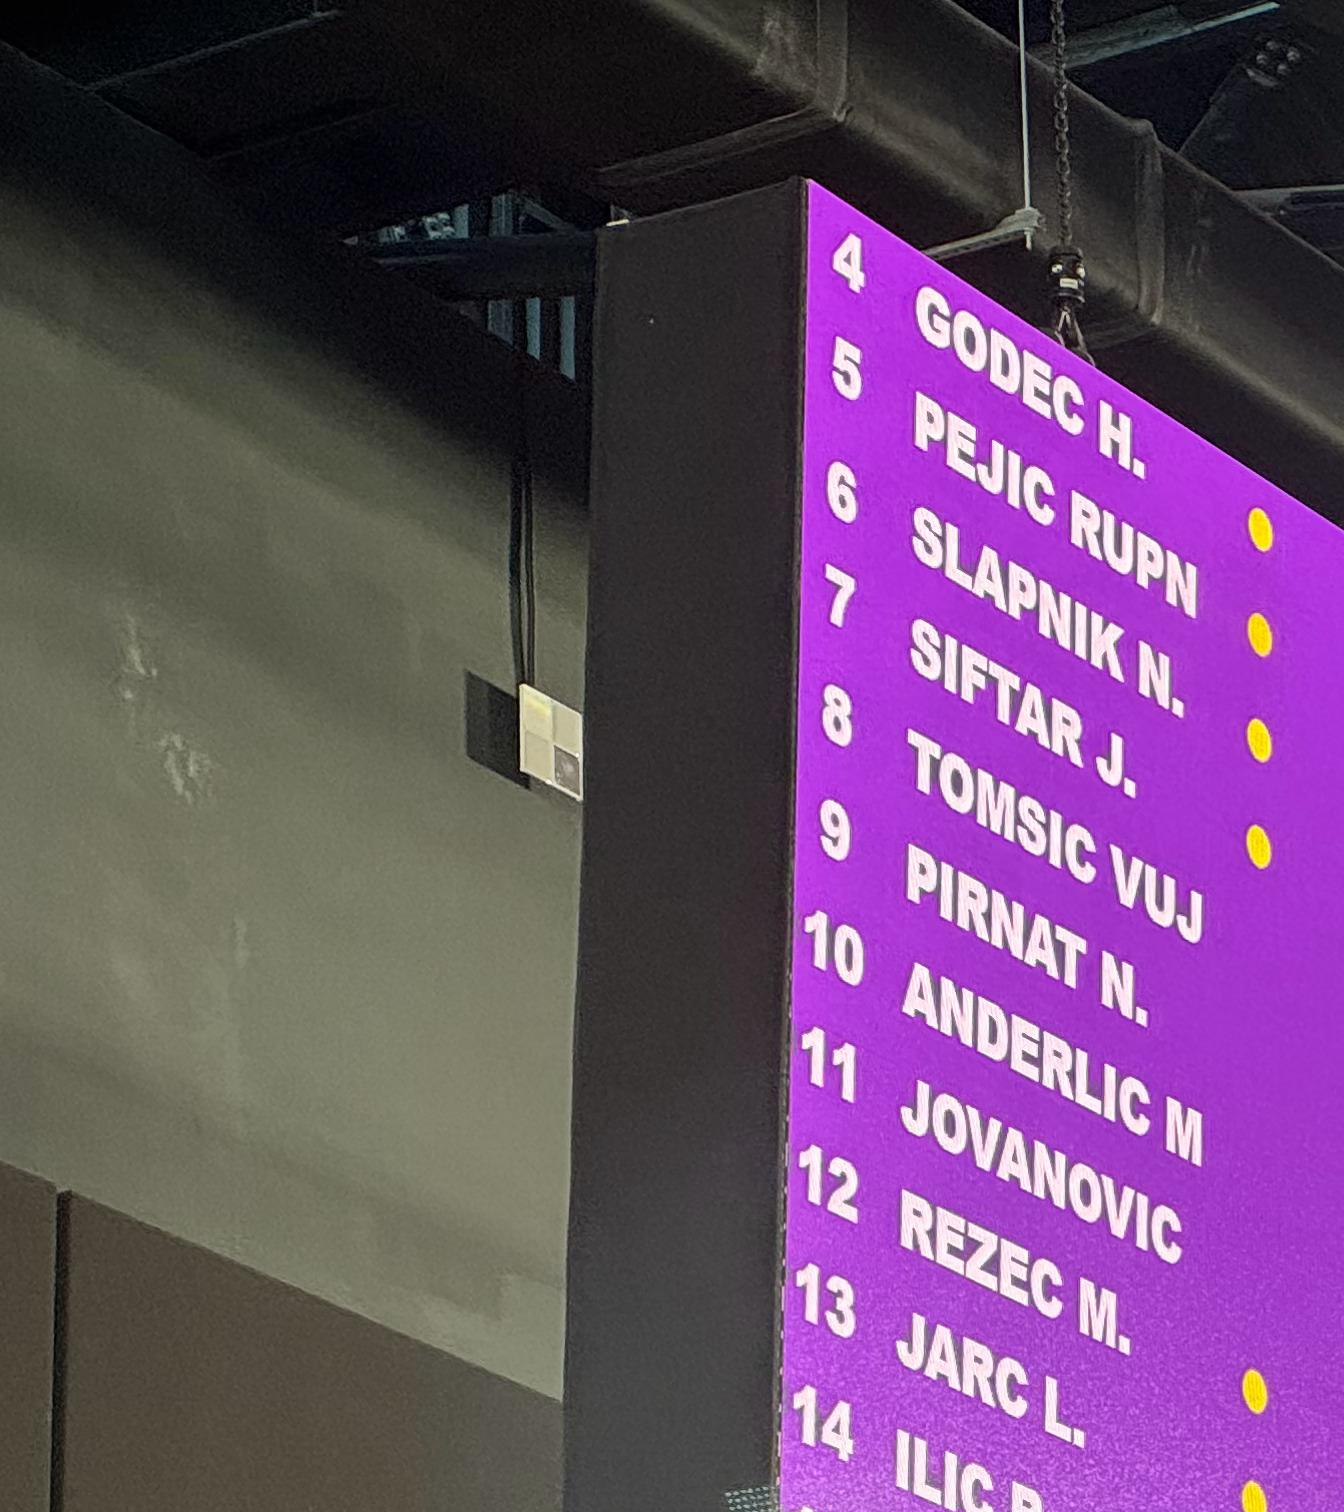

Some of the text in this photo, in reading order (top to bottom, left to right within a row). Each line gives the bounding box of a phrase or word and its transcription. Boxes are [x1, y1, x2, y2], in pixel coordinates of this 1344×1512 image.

[832, 234, 1146, 479] 4 GODEC H.
[827, 461, 1185, 718] 6 SLAPNIK N.
[831, 336, 1198, 618] 5 PEJIC RUPN
[824, 564, 1136, 798] 7 SIFTAR J.
[819, 799, 1150, 1028] 9 PIRNAT N.
[821, 684, 1202, 944] 8 TOMSIC VUJ
[802, 1027, 1183, 1265] 11 JOVANOVIC
[804, 910, 1204, 1167] 10 ANDERLIC M
[796, 1263, 1087, 1449] 13 JARC L.
[799, 1145, 1131, 1355] 12 REZEC M.
[793, 1385, 854, 1461] 14
